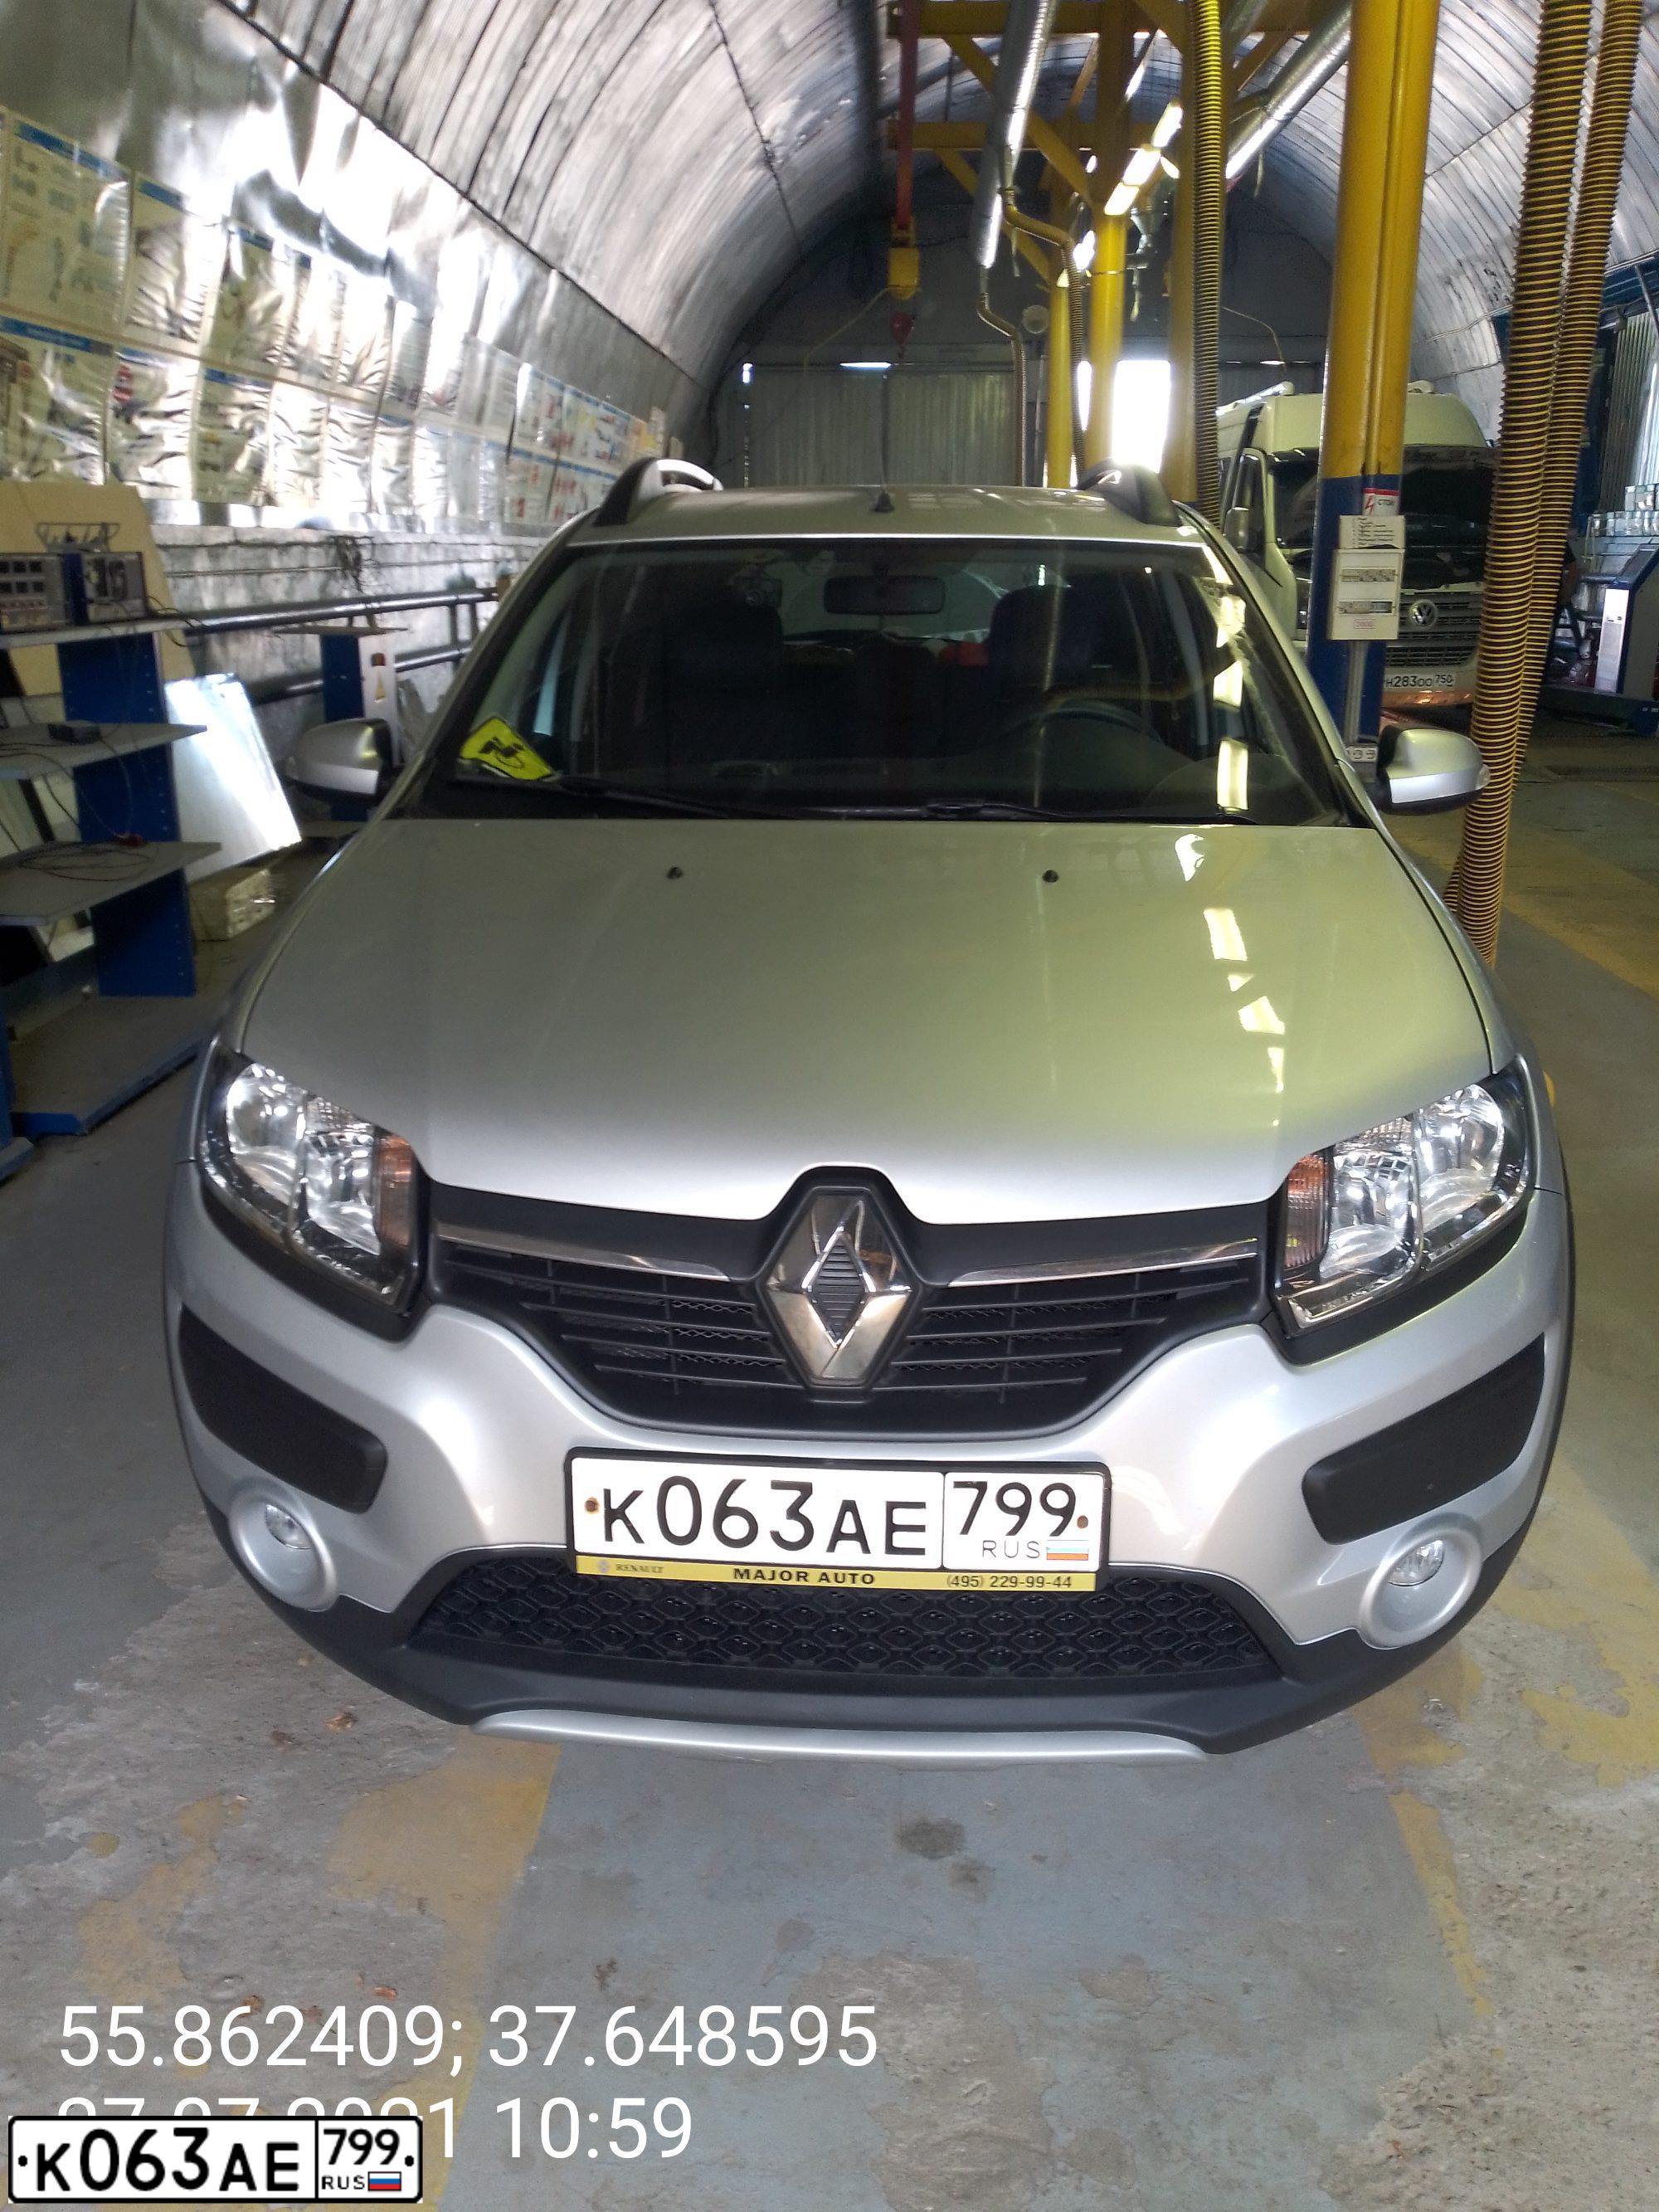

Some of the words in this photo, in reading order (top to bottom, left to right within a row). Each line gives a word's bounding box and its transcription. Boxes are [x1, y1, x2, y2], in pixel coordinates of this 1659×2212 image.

[603, 1475, 927, 1557] К063АЕ
[952, 1480, 1078, 1537] 799
[982, 1539, 1041, 1559] RUS
[733, 1567, 809, 1582] MAJOR
[818, 1571, 875, 1585] AUTO
[947, 1575, 983, 1588] (495)
[990, 1576, 1072, 1588] 229-99-44
